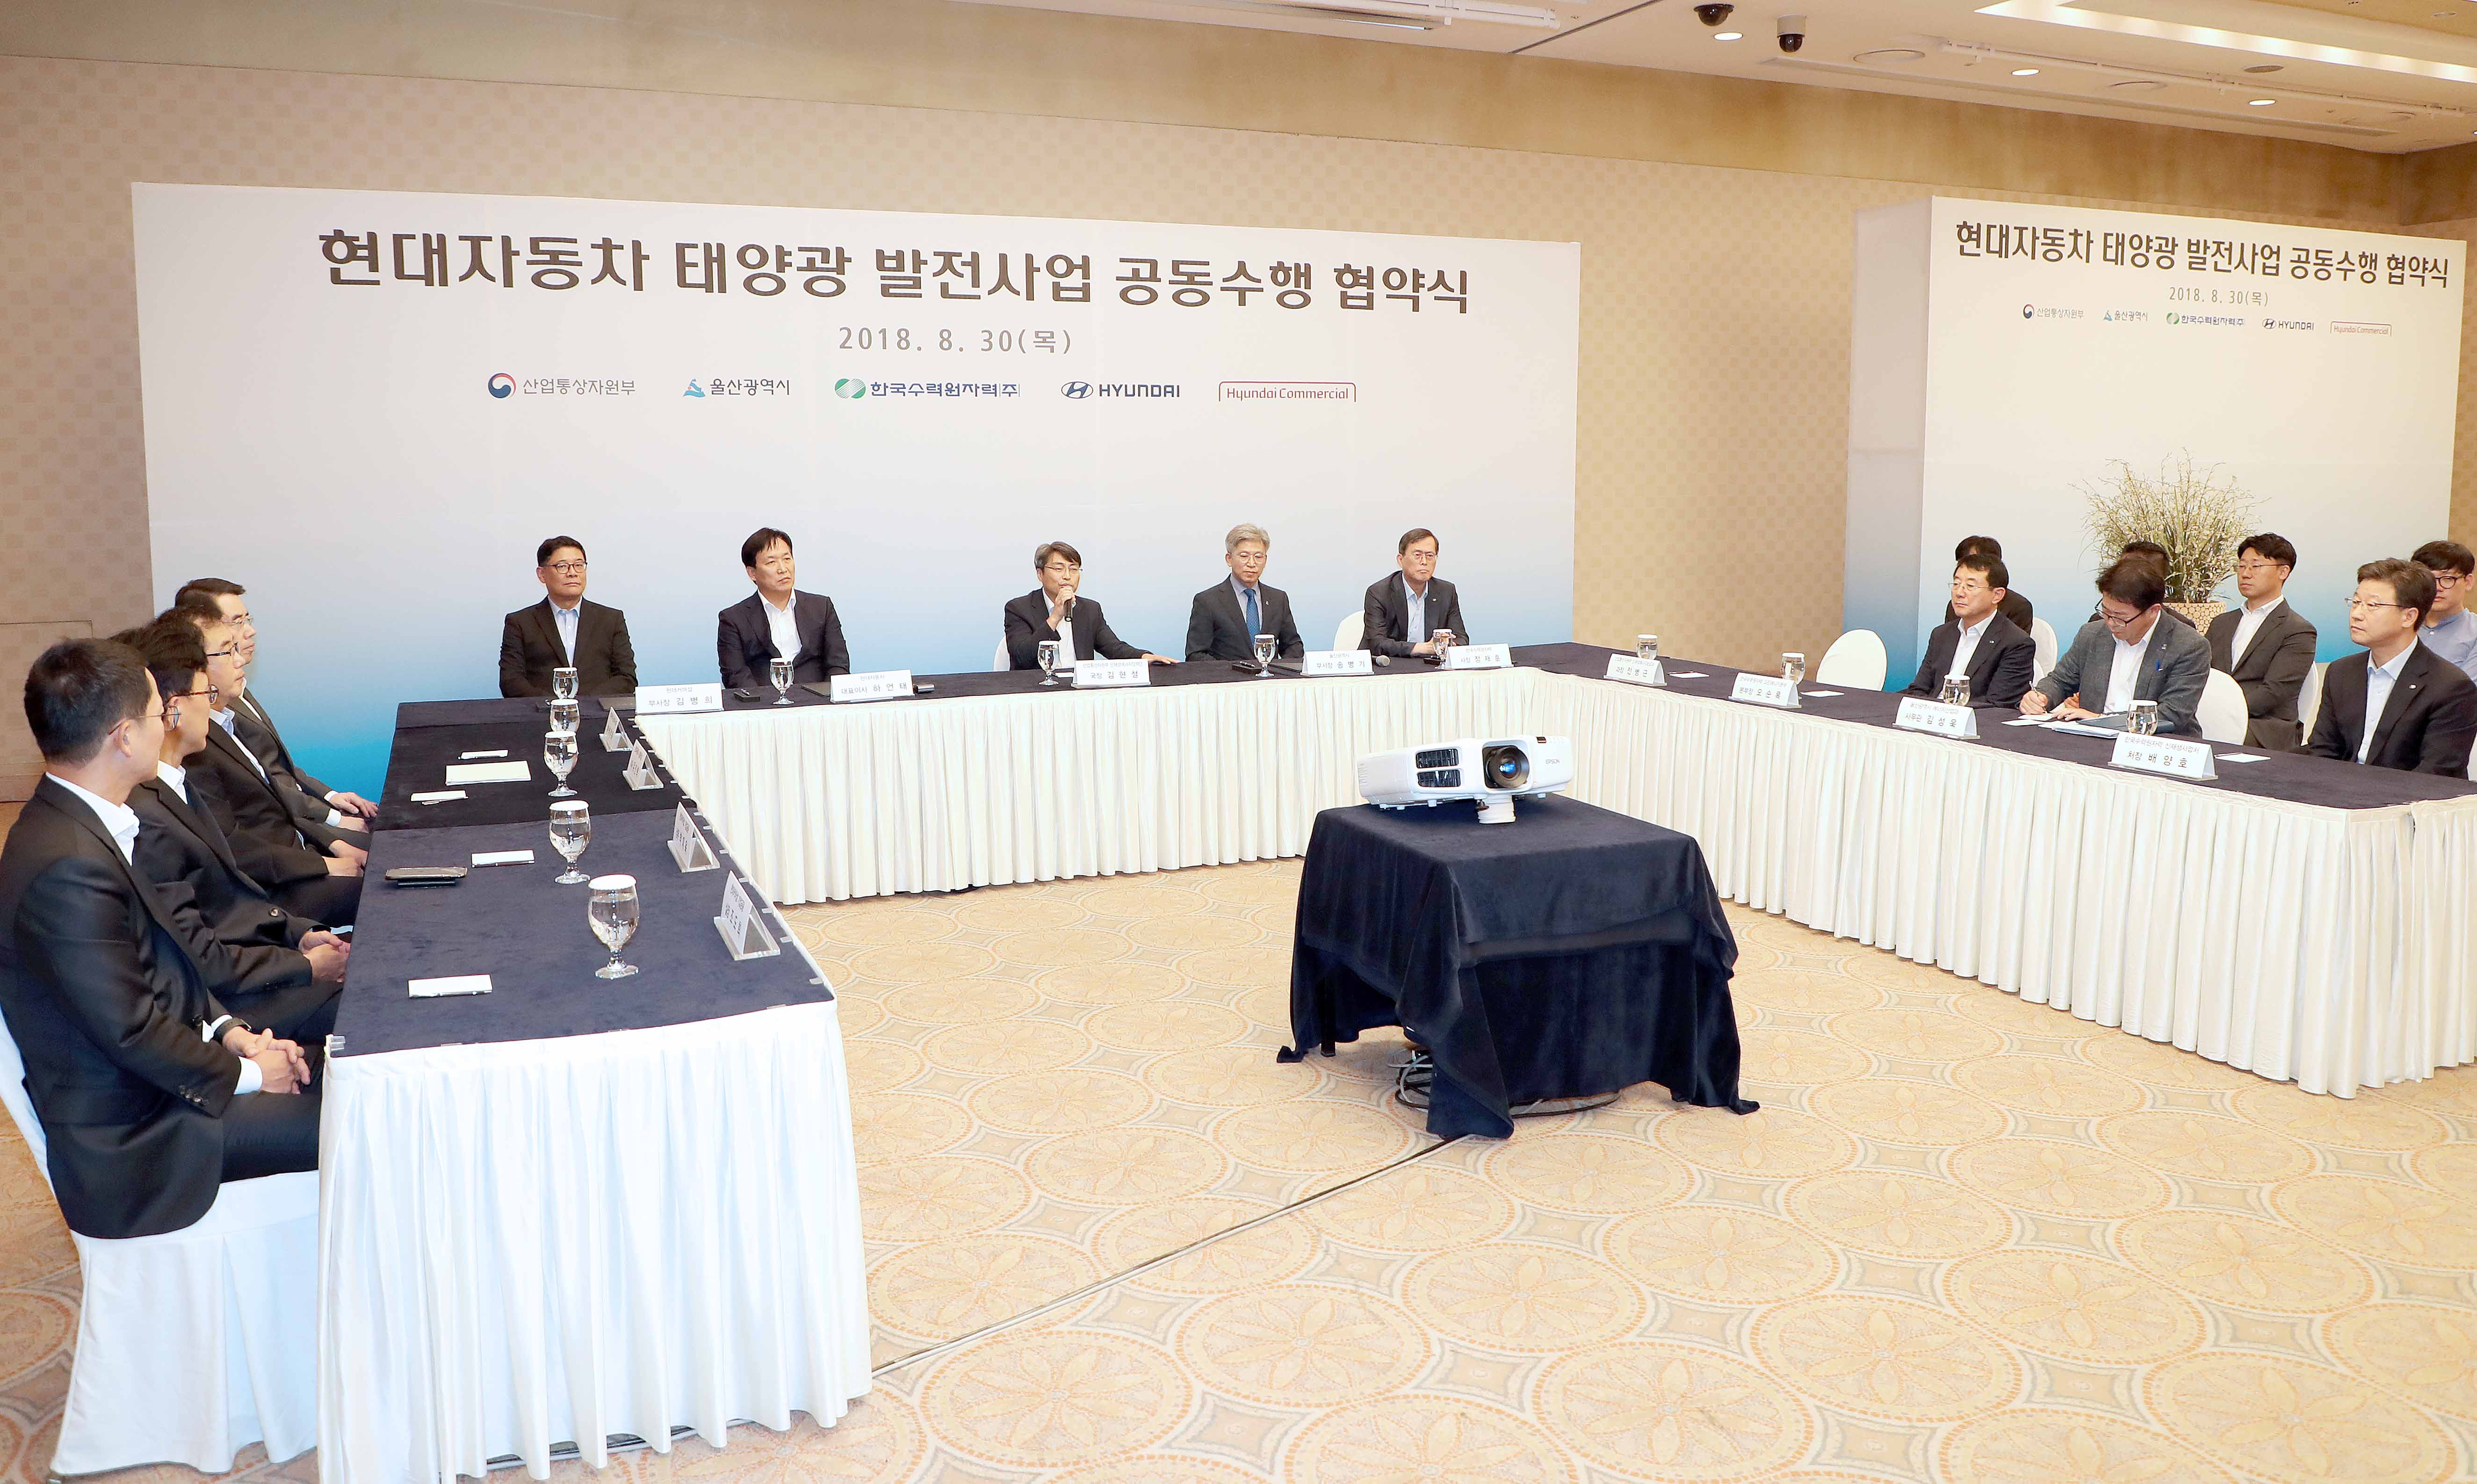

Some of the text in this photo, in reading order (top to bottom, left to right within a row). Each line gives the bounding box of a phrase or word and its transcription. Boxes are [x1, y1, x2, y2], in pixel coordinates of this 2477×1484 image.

[1957, 220, 2448, 288] 현대자동차 태양광 발전사업 공동수행 협약식
[318, 229, 1467, 314] 현대자동차 태양광 발전사업 공동수행 협약식
[2169, 287, 2268, 307] 2018. 8. 30(목)
[2037, 308, 2084, 319] 산업통상자원부
[2114, 310, 2148, 322] 울산광역시
[2278, 320, 2316, 331] HYUNDAI
[2334, 325, 2388, 335] Hyundai Commercial
[839, 326, 1070, 354] 2018. 8. 30(목)
[522, 378, 635, 396] 산업통상자원부
[709, 378, 790, 396] 울산광역시
[1098, 383, 1180, 398] HYUNDAI
[1227, 387, 1348, 402] Hyundai Commercial
[841, 686, 867, 694] 대표이사
[1905, 713, 1922, 722] 사무관
[2127, 750, 2142, 761] 처장
